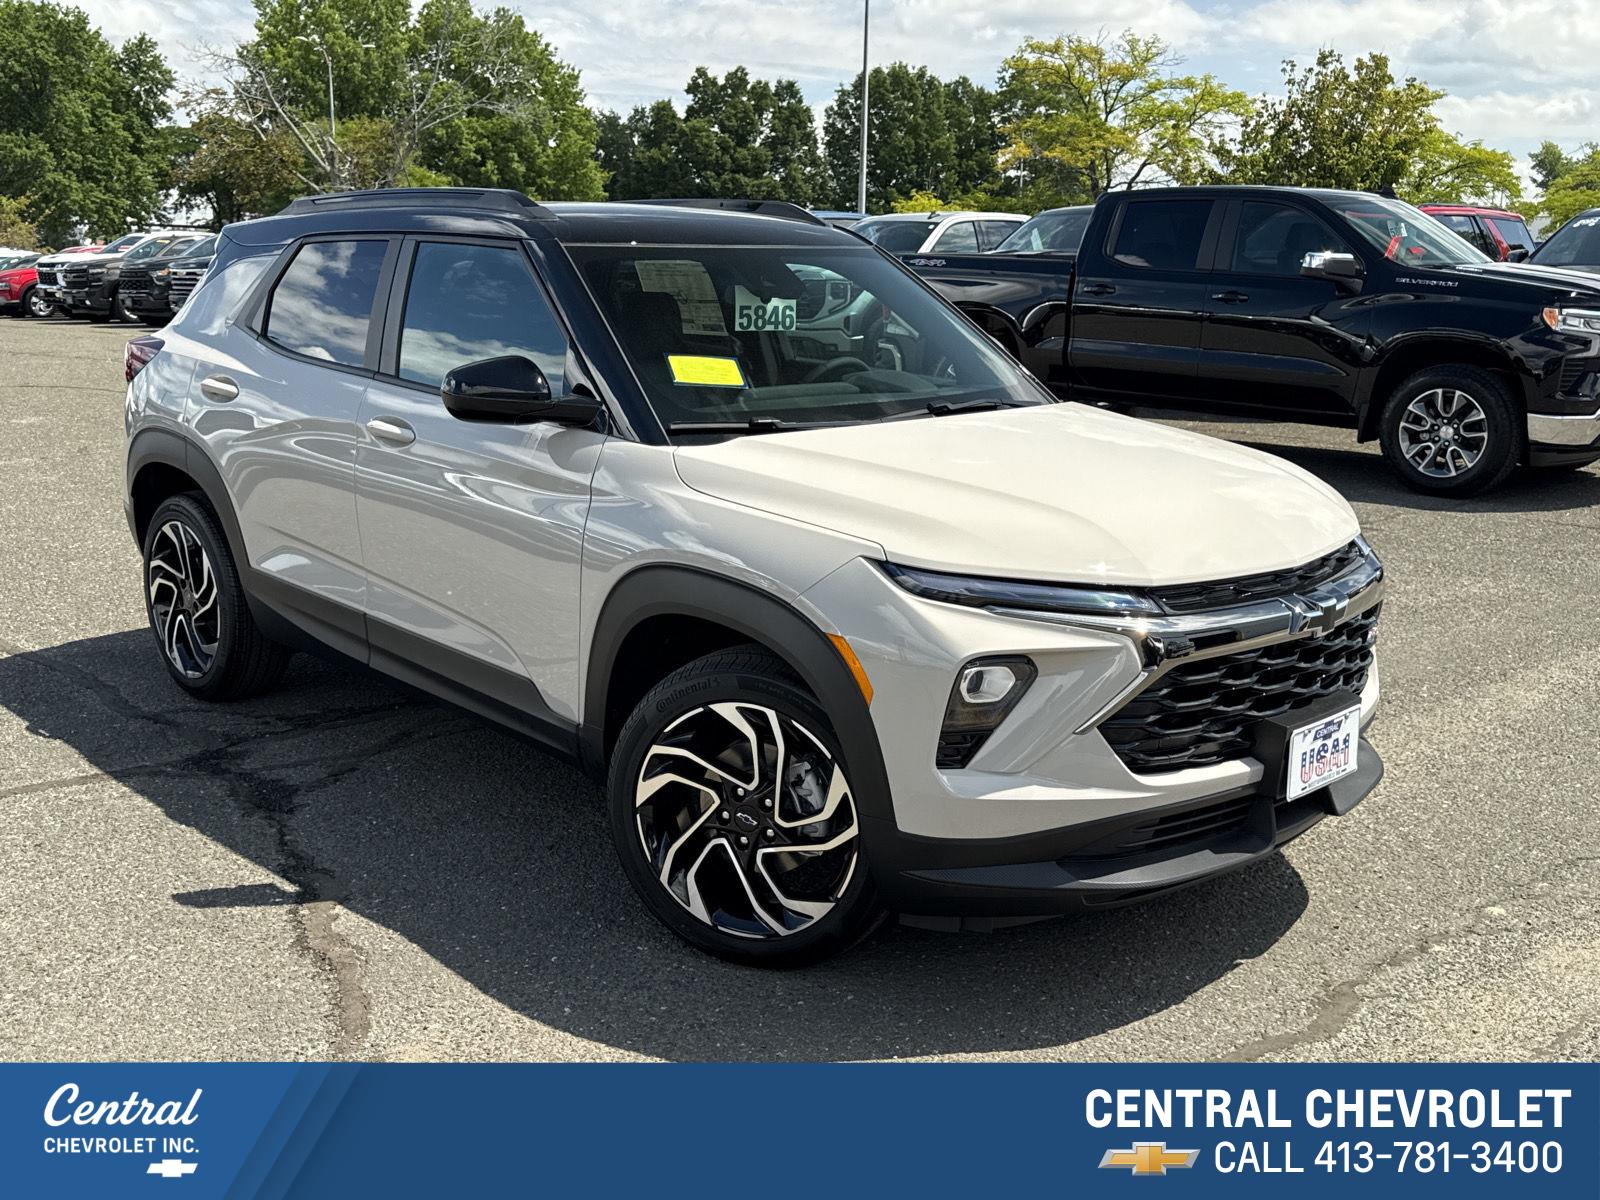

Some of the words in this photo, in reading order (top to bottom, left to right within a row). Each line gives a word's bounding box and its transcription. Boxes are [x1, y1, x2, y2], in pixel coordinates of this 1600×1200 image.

[738, 304, 795, 331] 5846
[656, 678, 712, 713] Continental
[1316, 724, 1339, 739] CENTRAL
